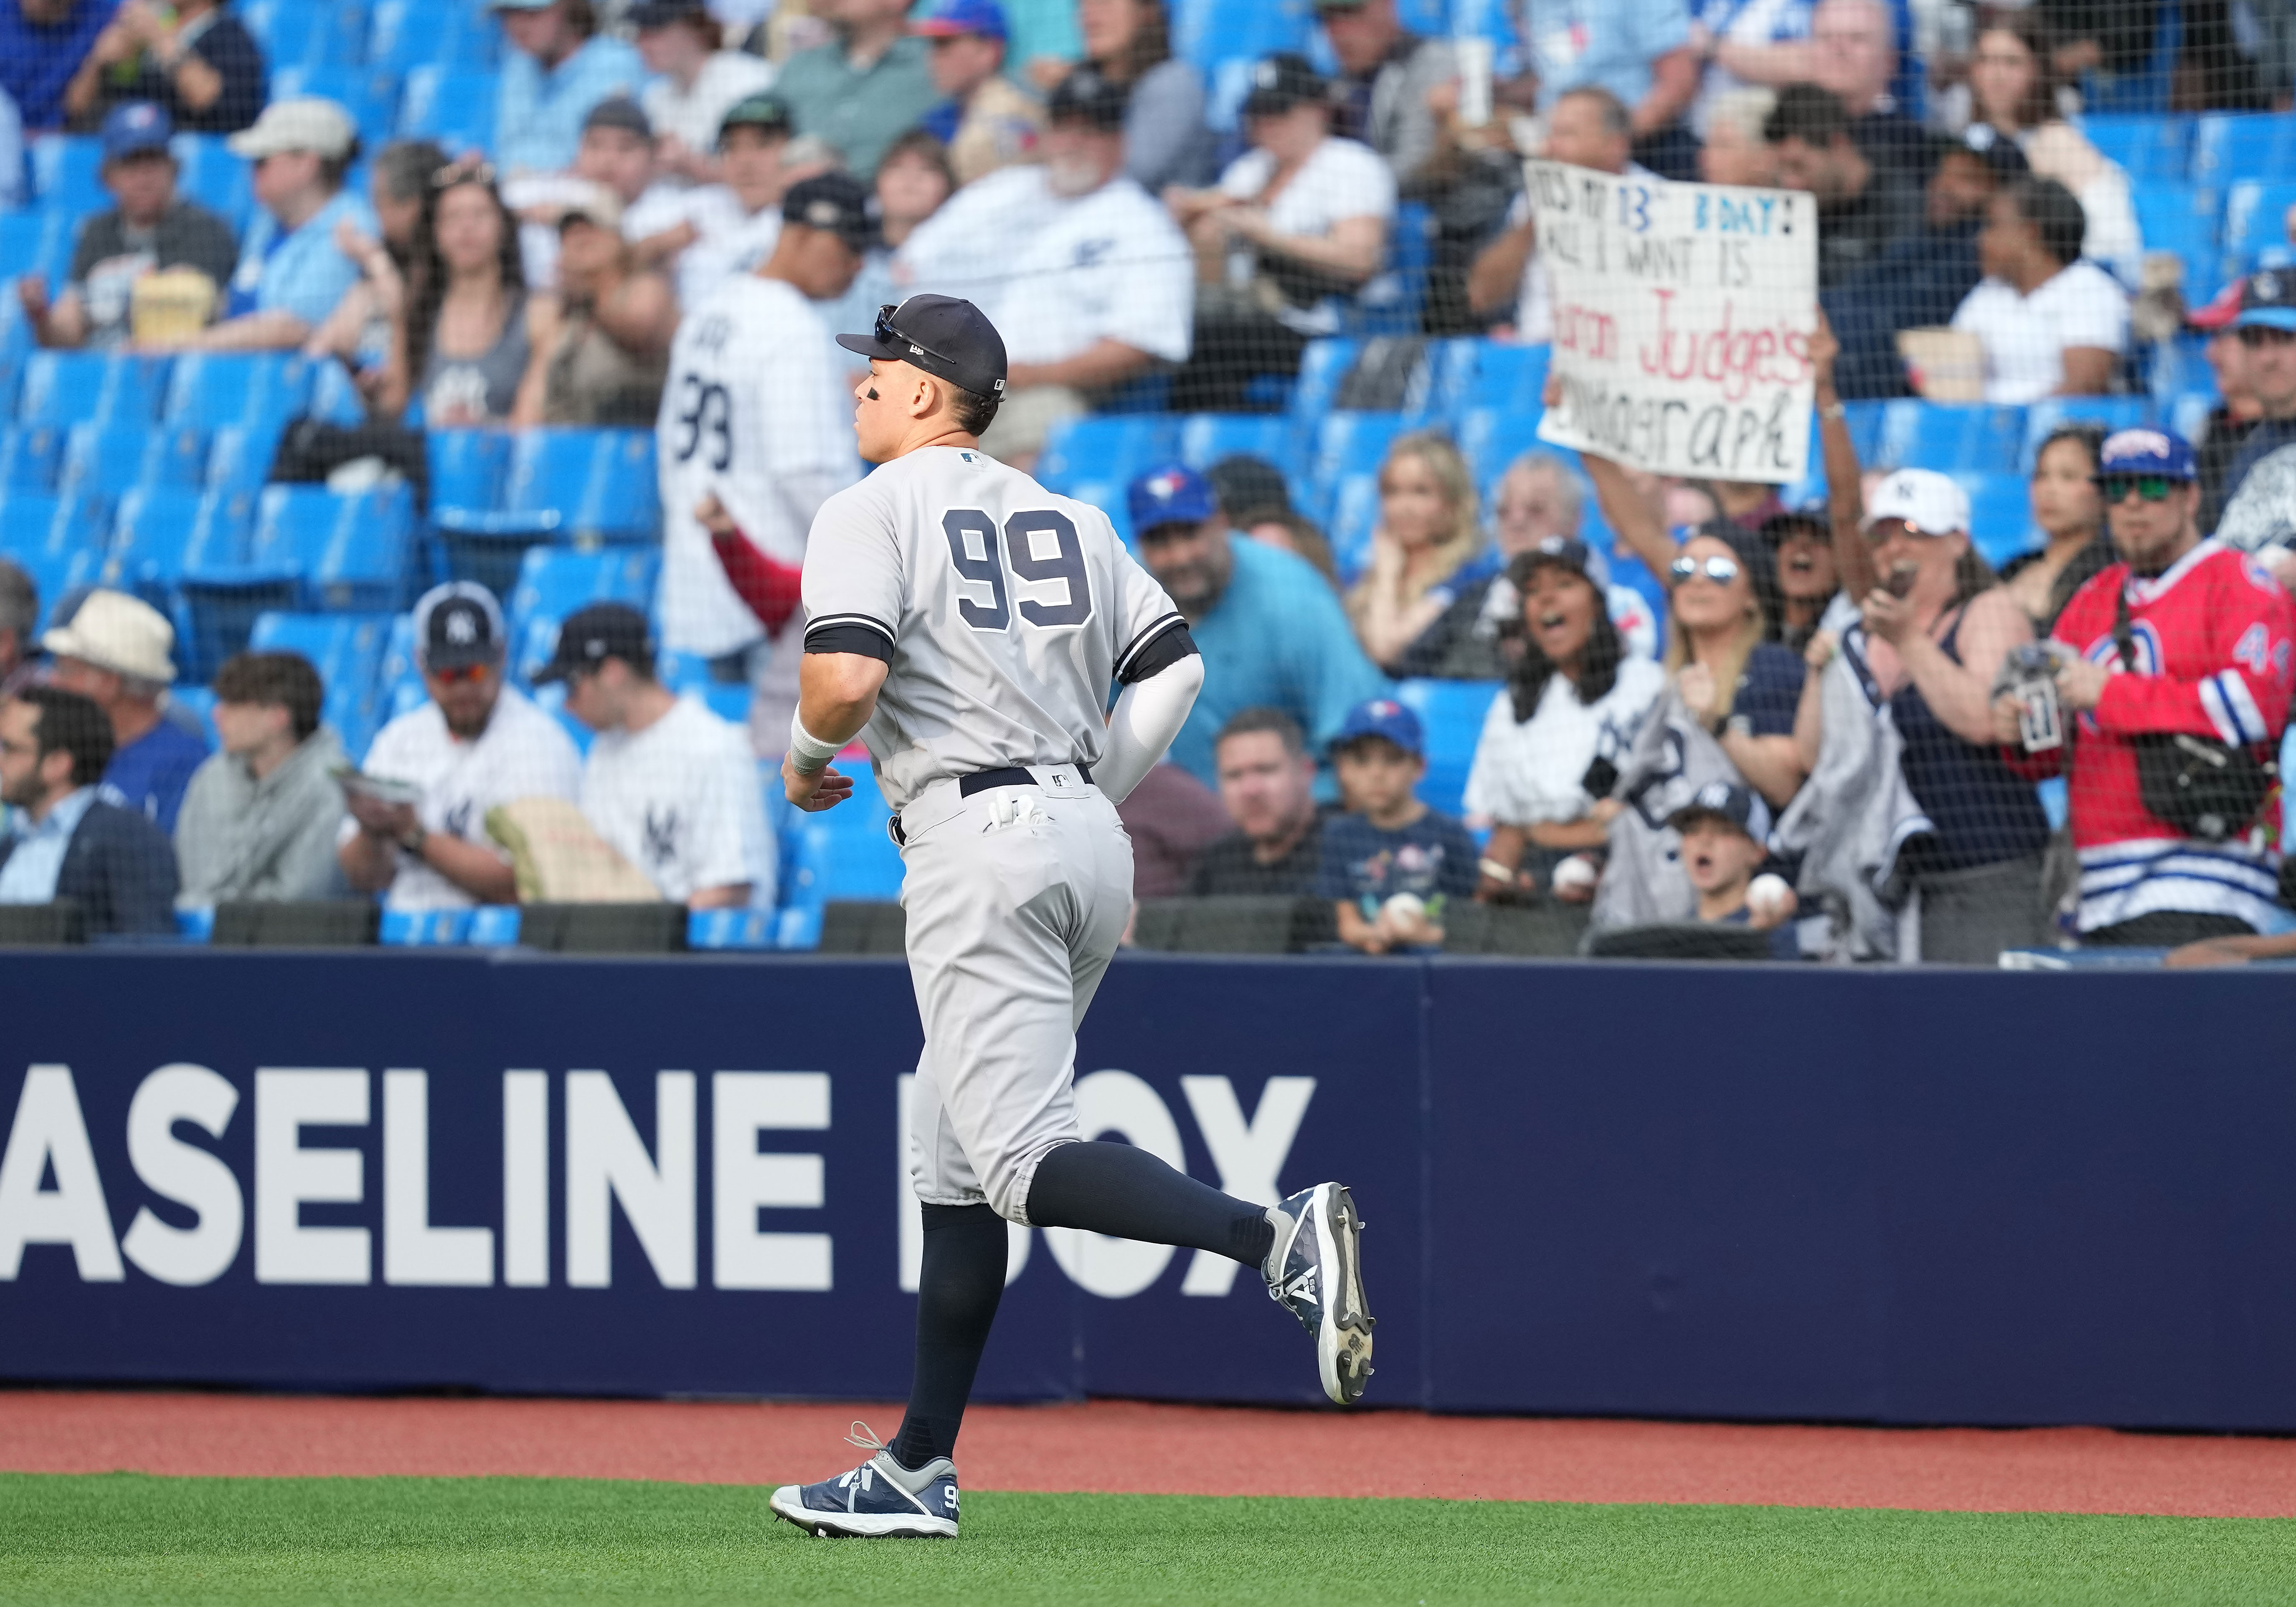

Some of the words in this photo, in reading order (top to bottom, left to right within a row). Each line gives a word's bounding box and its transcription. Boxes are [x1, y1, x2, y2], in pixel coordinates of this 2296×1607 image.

[1640, 288, 1812, 403] Judge's
[938, 506, 1094, 634] 99
[944, 1485, 960, 1513] 9
